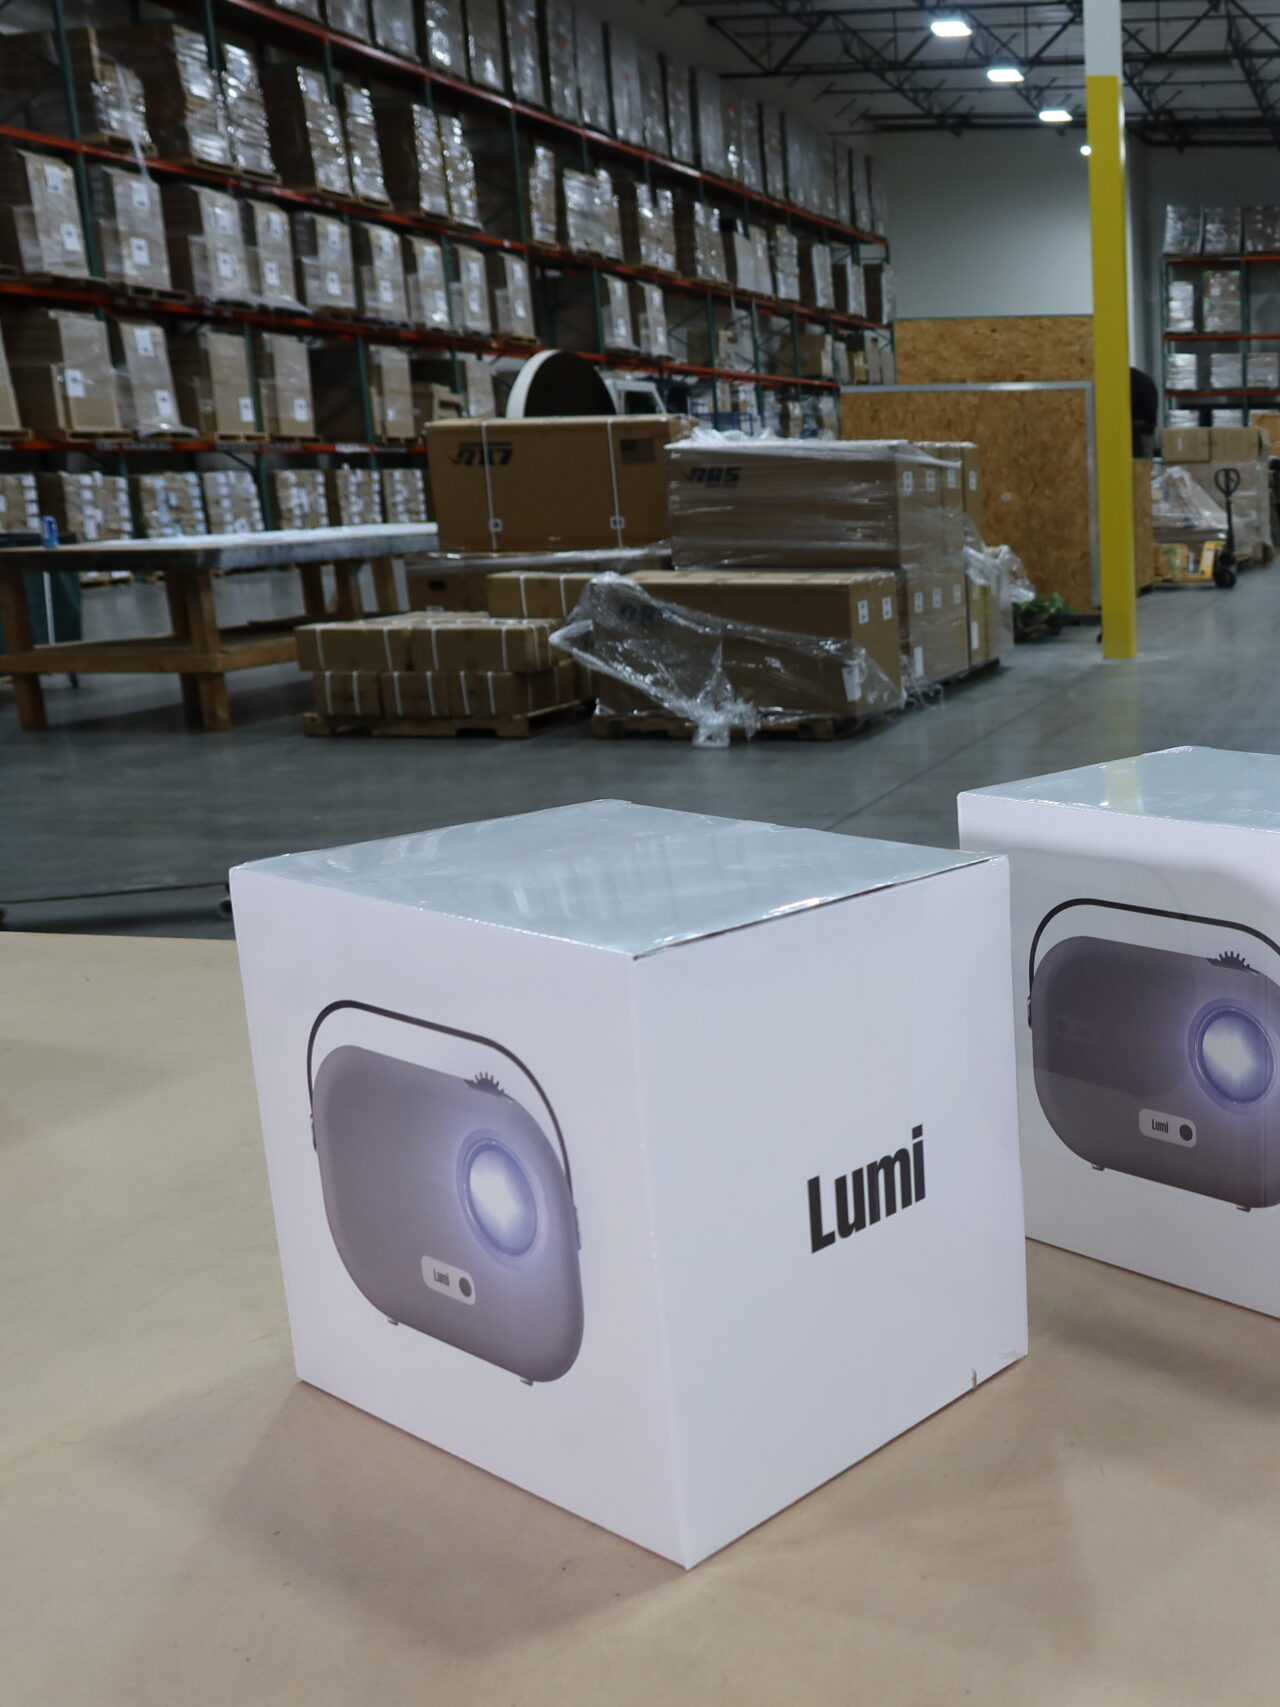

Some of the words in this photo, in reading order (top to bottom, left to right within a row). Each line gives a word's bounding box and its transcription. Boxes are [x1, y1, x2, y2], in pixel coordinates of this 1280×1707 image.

[1151, 1118, 1169, 1134] Lumi
[808, 1125, 925, 1254] Lumi
[433, 1267, 450, 1287] Lumi
